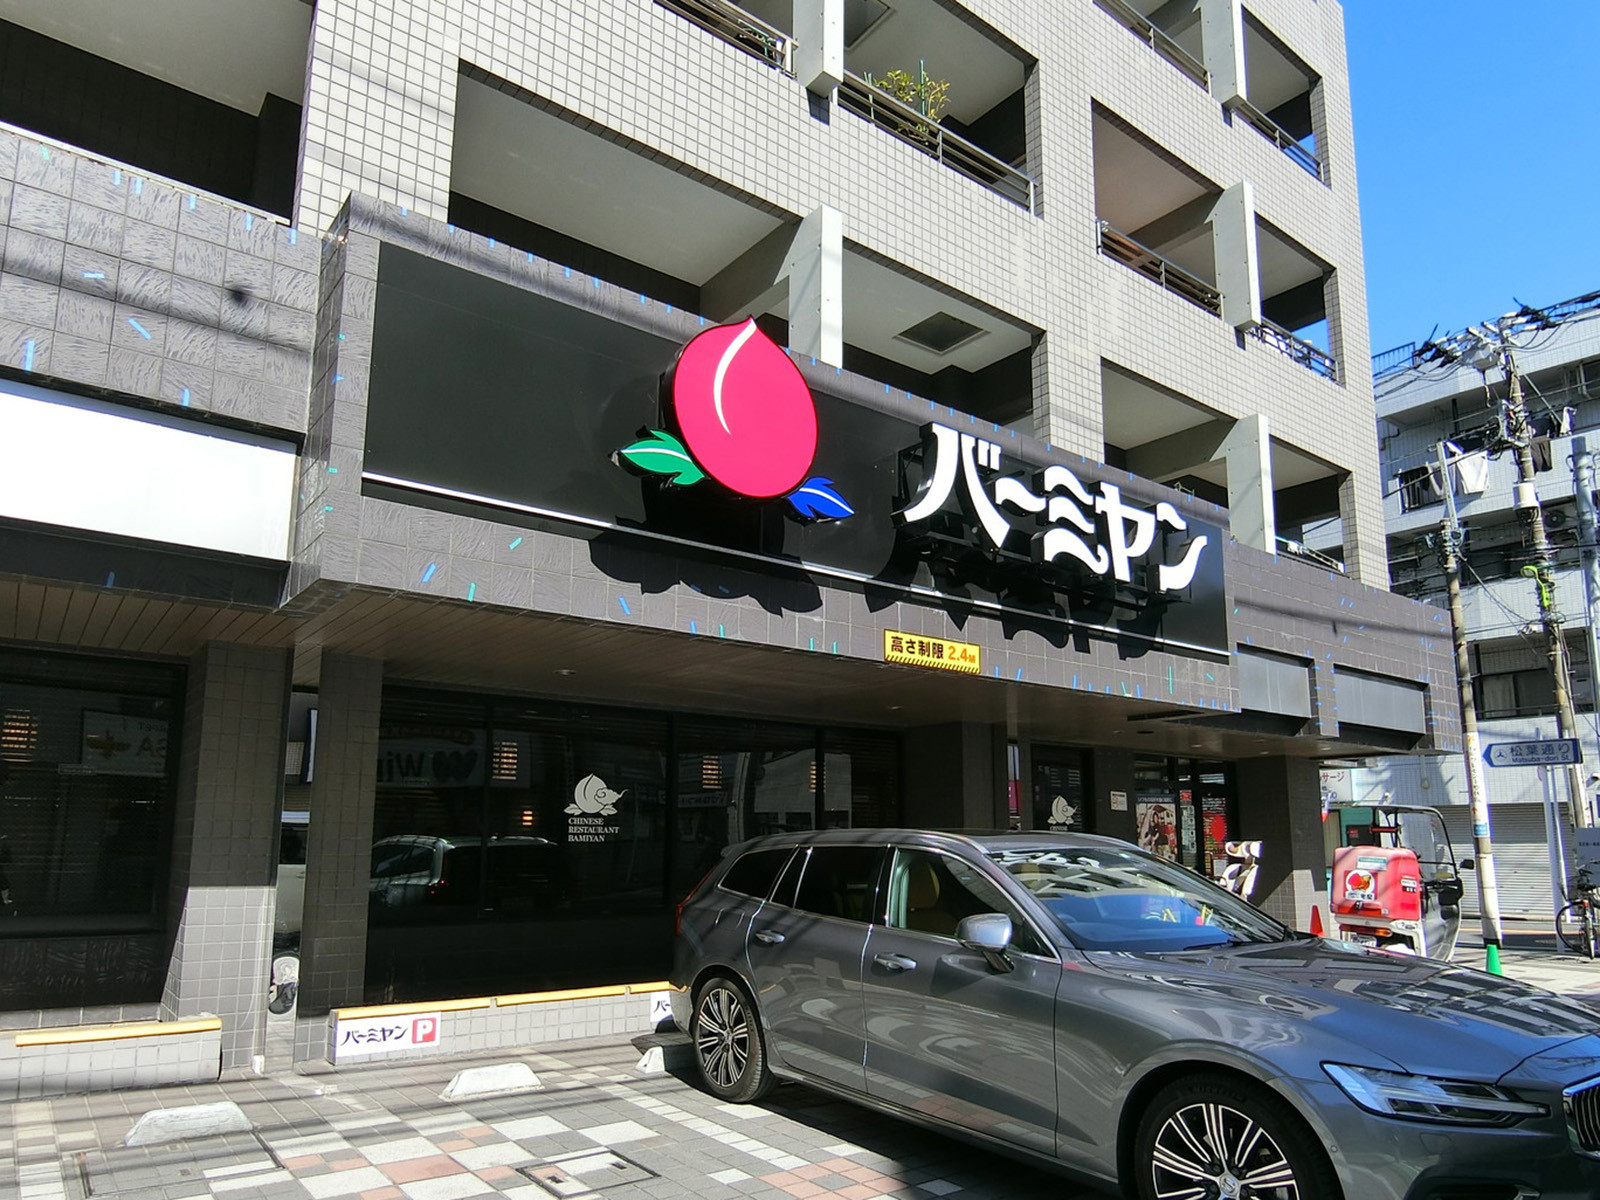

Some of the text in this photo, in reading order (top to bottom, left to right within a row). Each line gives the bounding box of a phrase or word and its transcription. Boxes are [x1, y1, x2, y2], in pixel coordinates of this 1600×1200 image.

[904, 423, 1208, 592] バーミヤン
[891, 636, 944, 659] 高さ制限
[1510, 743, 1570, 757] 松葉通り
[1320, 771, 1345, 783] サージ
[568, 817, 604, 825] CHINESE
[568, 826, 620, 834] RESTAURANT
[568, 834, 605, 842] BAMIYAN
[341, 1019, 434, 1046] バーミヤン P
